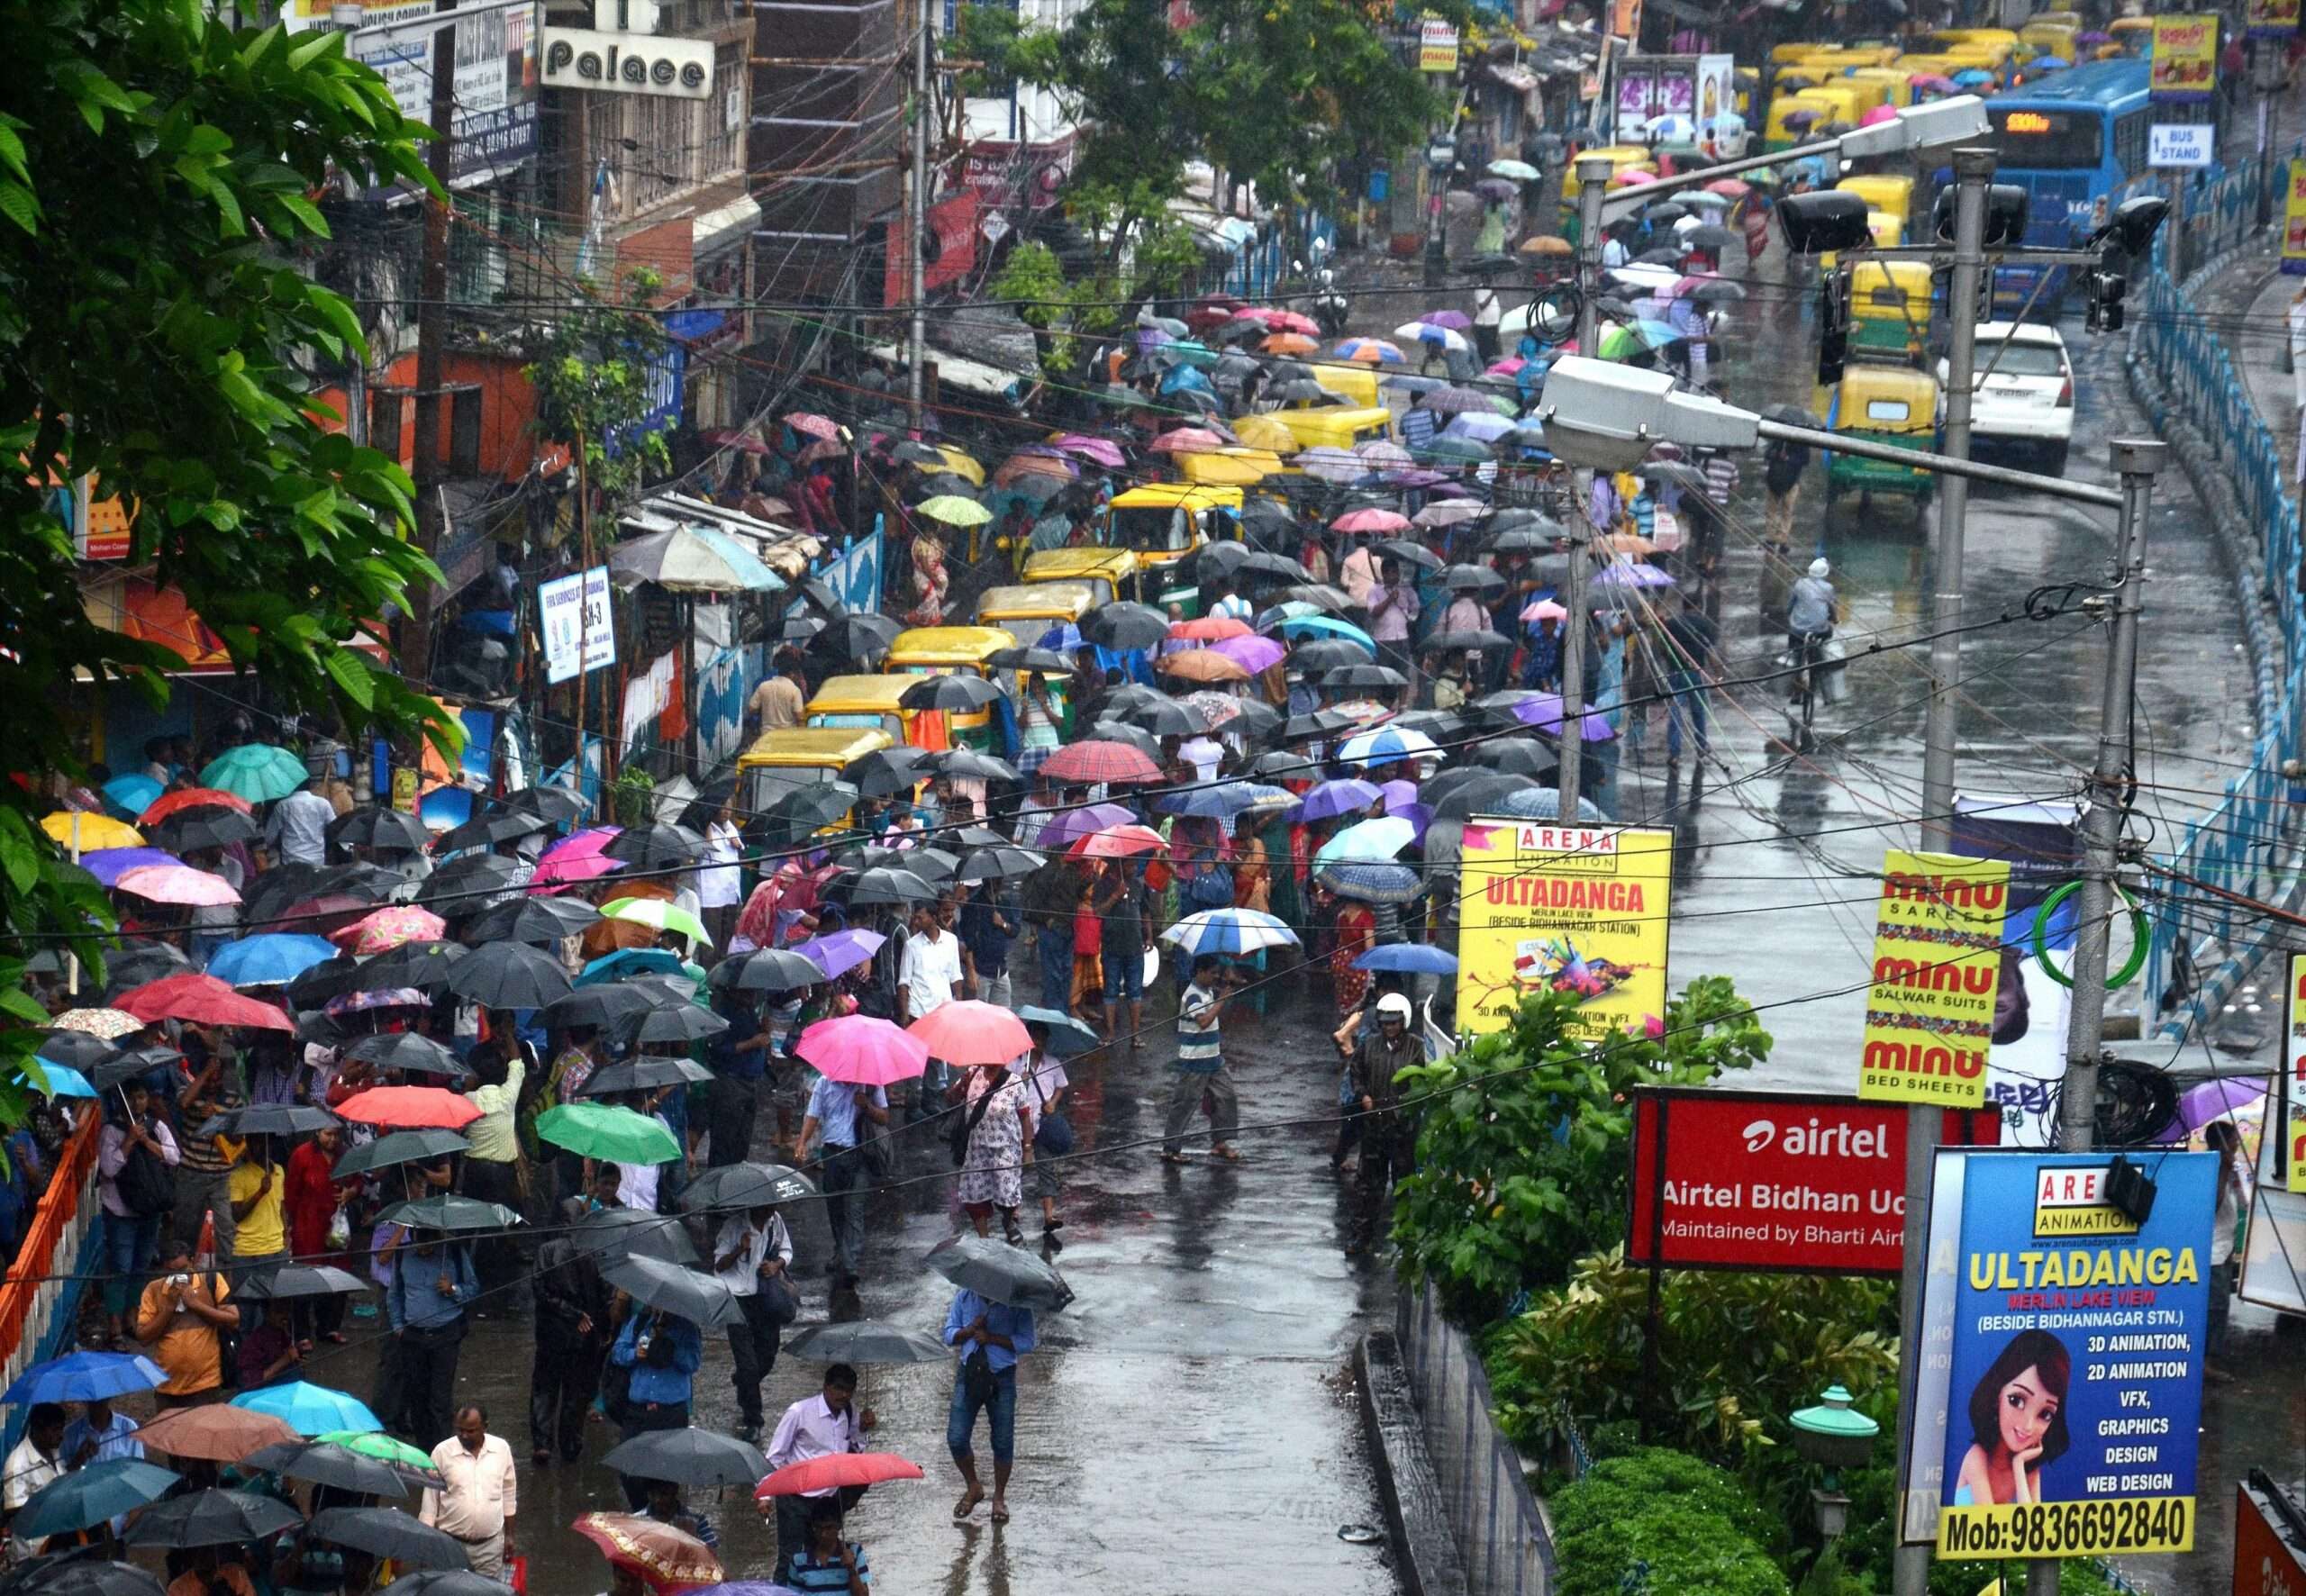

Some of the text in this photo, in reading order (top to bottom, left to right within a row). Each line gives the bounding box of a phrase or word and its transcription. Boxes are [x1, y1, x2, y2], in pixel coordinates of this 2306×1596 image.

[547, 39, 705, 88] Palace
[2169, 130, 2194, 142] BUS
[2162, 146, 2201, 159] STAND
[1522, 829, 1612, 850] ARENA
[1521, 852, 1613, 867] ANIMATION
[1485, 876, 1645, 912] ULTADANGA
[1884, 871, 2004, 910] minu
[1576, 910, 1593, 919] VIEW
[1890, 903, 1993, 924] SAREES
[1489, 915, 1640, 937] (BESIDE BIDHANNAGAR STATION)
[1874, 957, 1993, 995] minu
[1875, 989, 1987, 1011] SALWAR SUITS
[1864, 1040, 1984, 1079] minu
[1866, 1075, 1975, 1096] BED SHEETS
[1783, 1118, 1889, 1158] airtel
[1664, 1180, 1742, 1207] Airtel
[1751, 1184, 1860, 1213] Bidhan
[2042, 1174, 2096, 1201] ARE
[1662, 1219, 1770, 1241] Maintained
[1775, 1224, 1800, 1246] by
[1804, 1225, 1866, 1246] Bharti
[1969, 1247, 2200, 1290] ULTADANGA
[2008, 1290, 2157, 1311] MERLIN LAKE VIEW
[1978, 1310, 2184, 1333] (BESIDE BIDHANNAGAR STN.)
[2088, 1334, 2191, 1353] 3D ANIMATION,
[2087, 1362, 2187, 1380] 2D ANIMATION
[2120, 1391, 2151, 1410] VFX,
[2098, 1418, 2169, 1436] GRAPHICS
[2105, 1446, 2157, 1464] DESIGN
[2087, 1474, 2173, 1492] WEB DESIGN
[1946, 1499, 2185, 1553] Mob:9836692840
